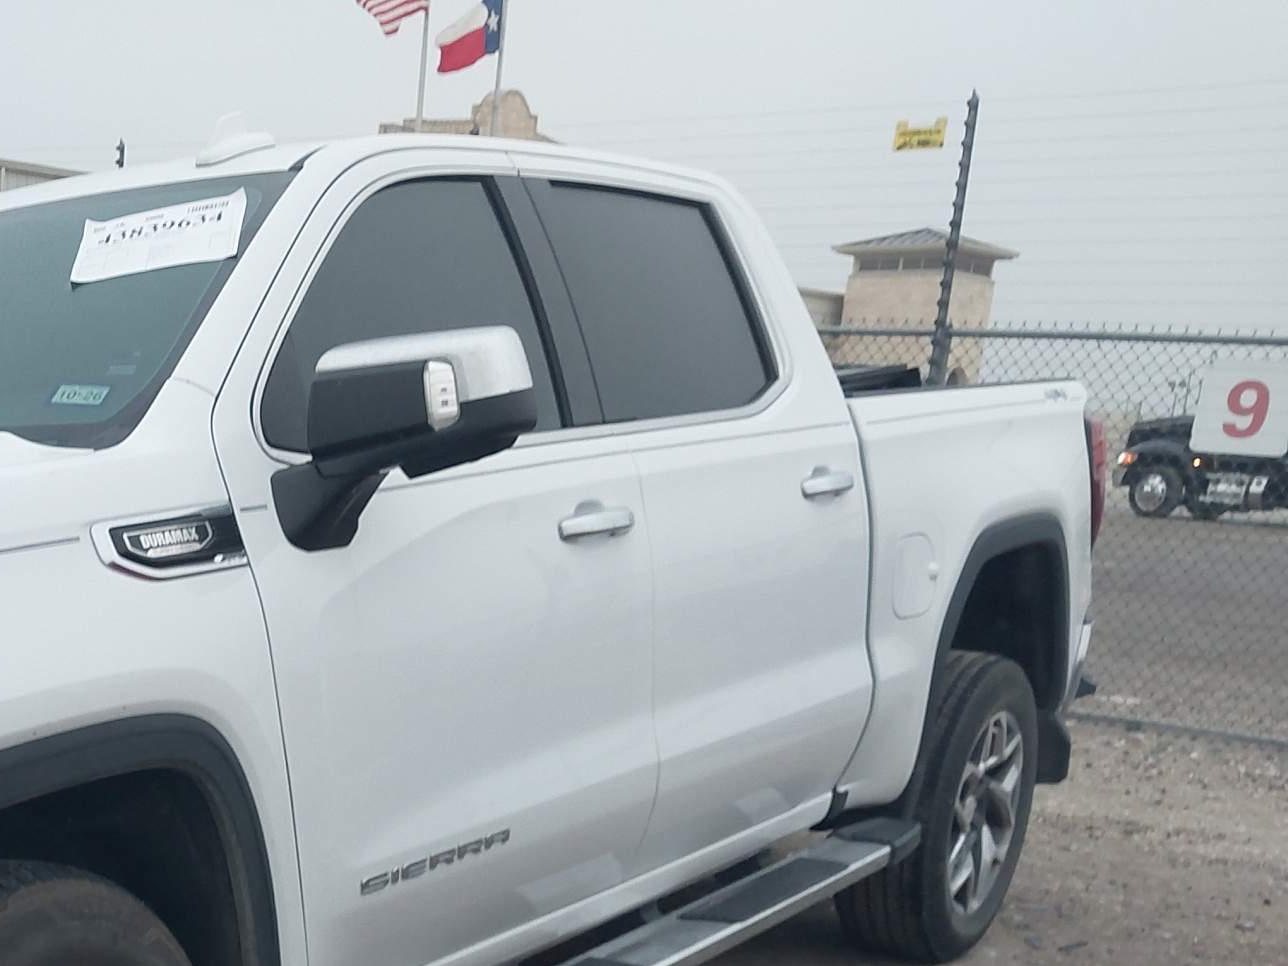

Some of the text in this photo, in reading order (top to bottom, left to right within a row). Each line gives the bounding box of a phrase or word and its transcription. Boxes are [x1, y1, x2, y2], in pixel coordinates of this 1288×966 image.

[1223, 380, 1270, 438] 9
[139, 526, 199, 549] DURAMAX
[360, 829, 511, 896] SIERRA
